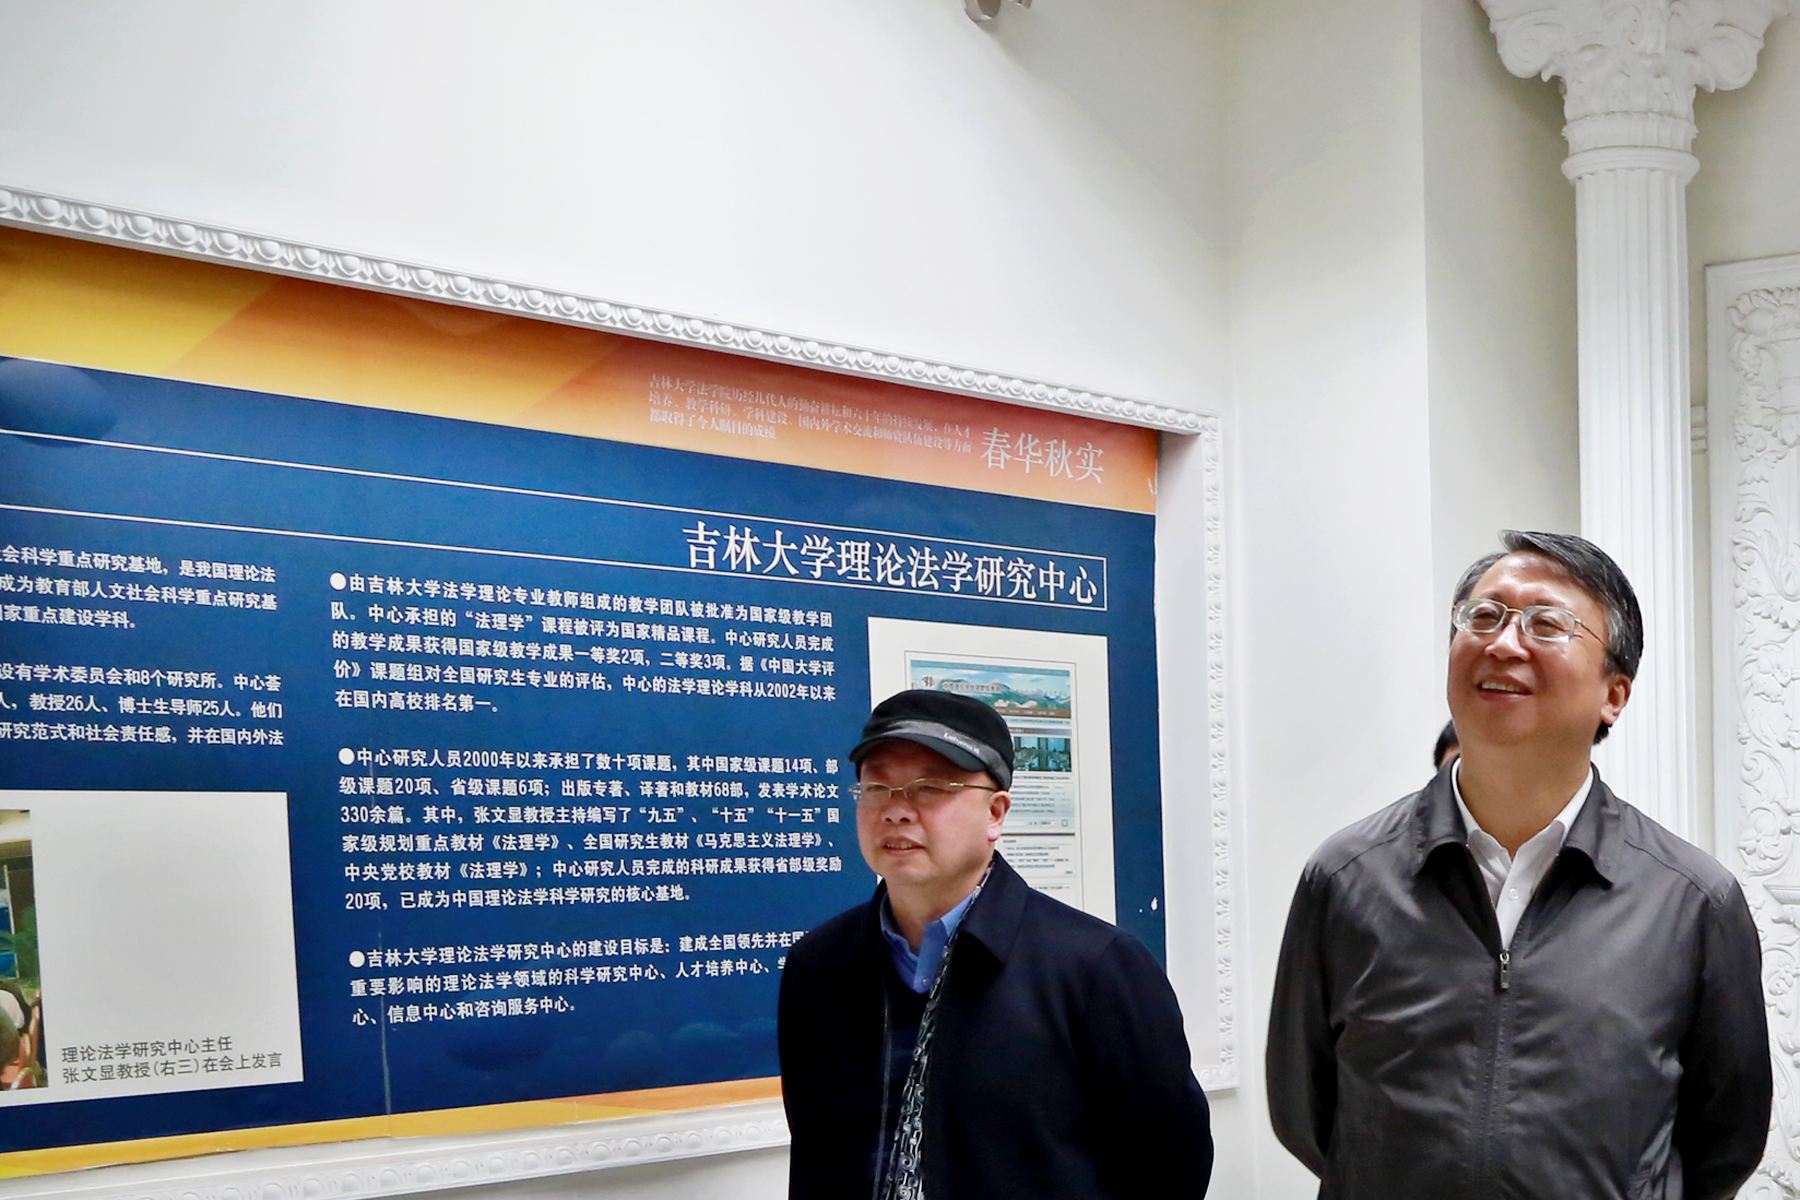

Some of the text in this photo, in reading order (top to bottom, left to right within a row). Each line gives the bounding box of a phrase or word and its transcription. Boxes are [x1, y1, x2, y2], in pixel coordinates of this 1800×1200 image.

[980, 427, 1105, 484] 春华秋实
[0, 545, 277, 583] 会科学重点研究基地，是我国理论法
[682, 520, 1098, 605] 吉林大学理论法学研究中心
[0, 604, 136, 630] 家重点建设学科。
[335, 689, 498, 713] 在国内高校排名第一。
[352, 995, 576, 1027] 心、信息中心和咨询服务中心。
[61, 1035, 233, 1064] 理论法学研究中心主任
[62, 1052, 283, 1084] 张文显教授(右三)在会上发言
